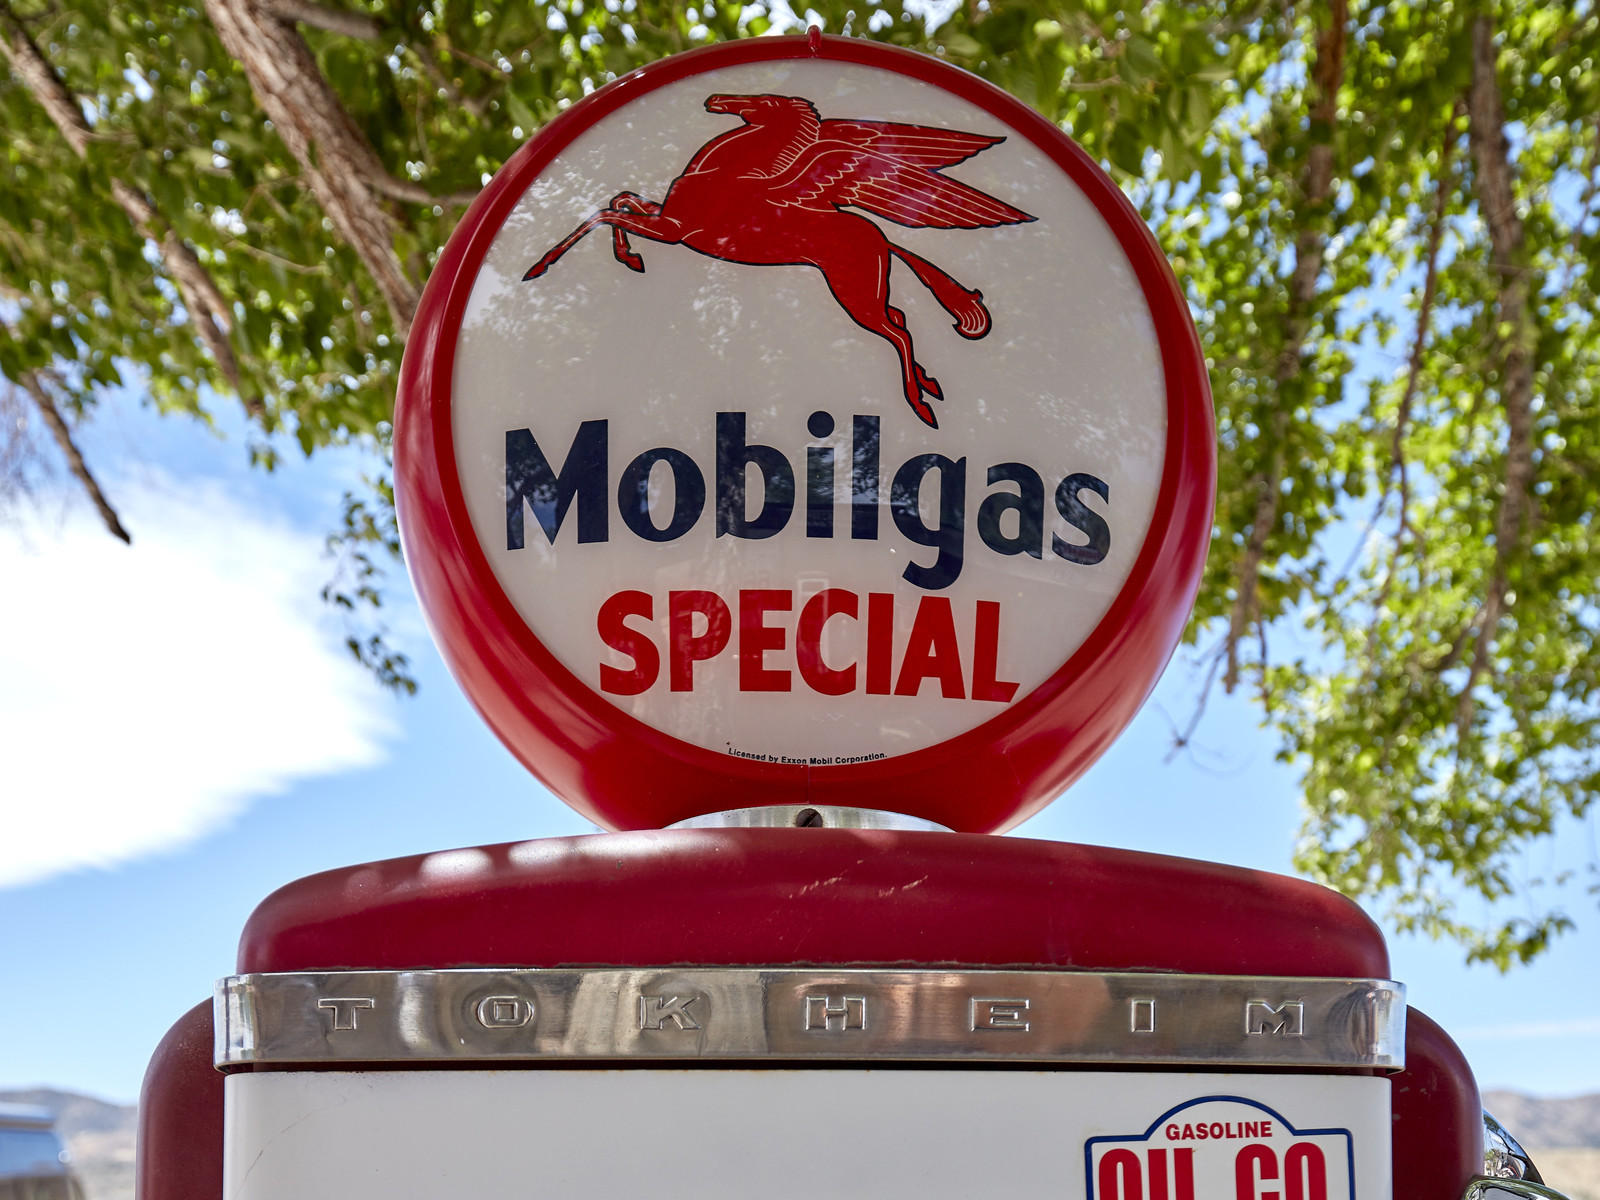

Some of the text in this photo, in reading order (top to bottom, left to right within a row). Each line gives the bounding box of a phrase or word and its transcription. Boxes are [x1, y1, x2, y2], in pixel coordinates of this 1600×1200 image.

[505, 411, 1111, 590] Mobilgas
[597, 588, 1020, 703] SPECIAL
[728, 747, 888, 765] Licensed by Exxon Mobil Corporation.
[317, 995, 1304, 1036] TOKHEIM
[1165, 1121, 1272, 1141] GASOLINE
